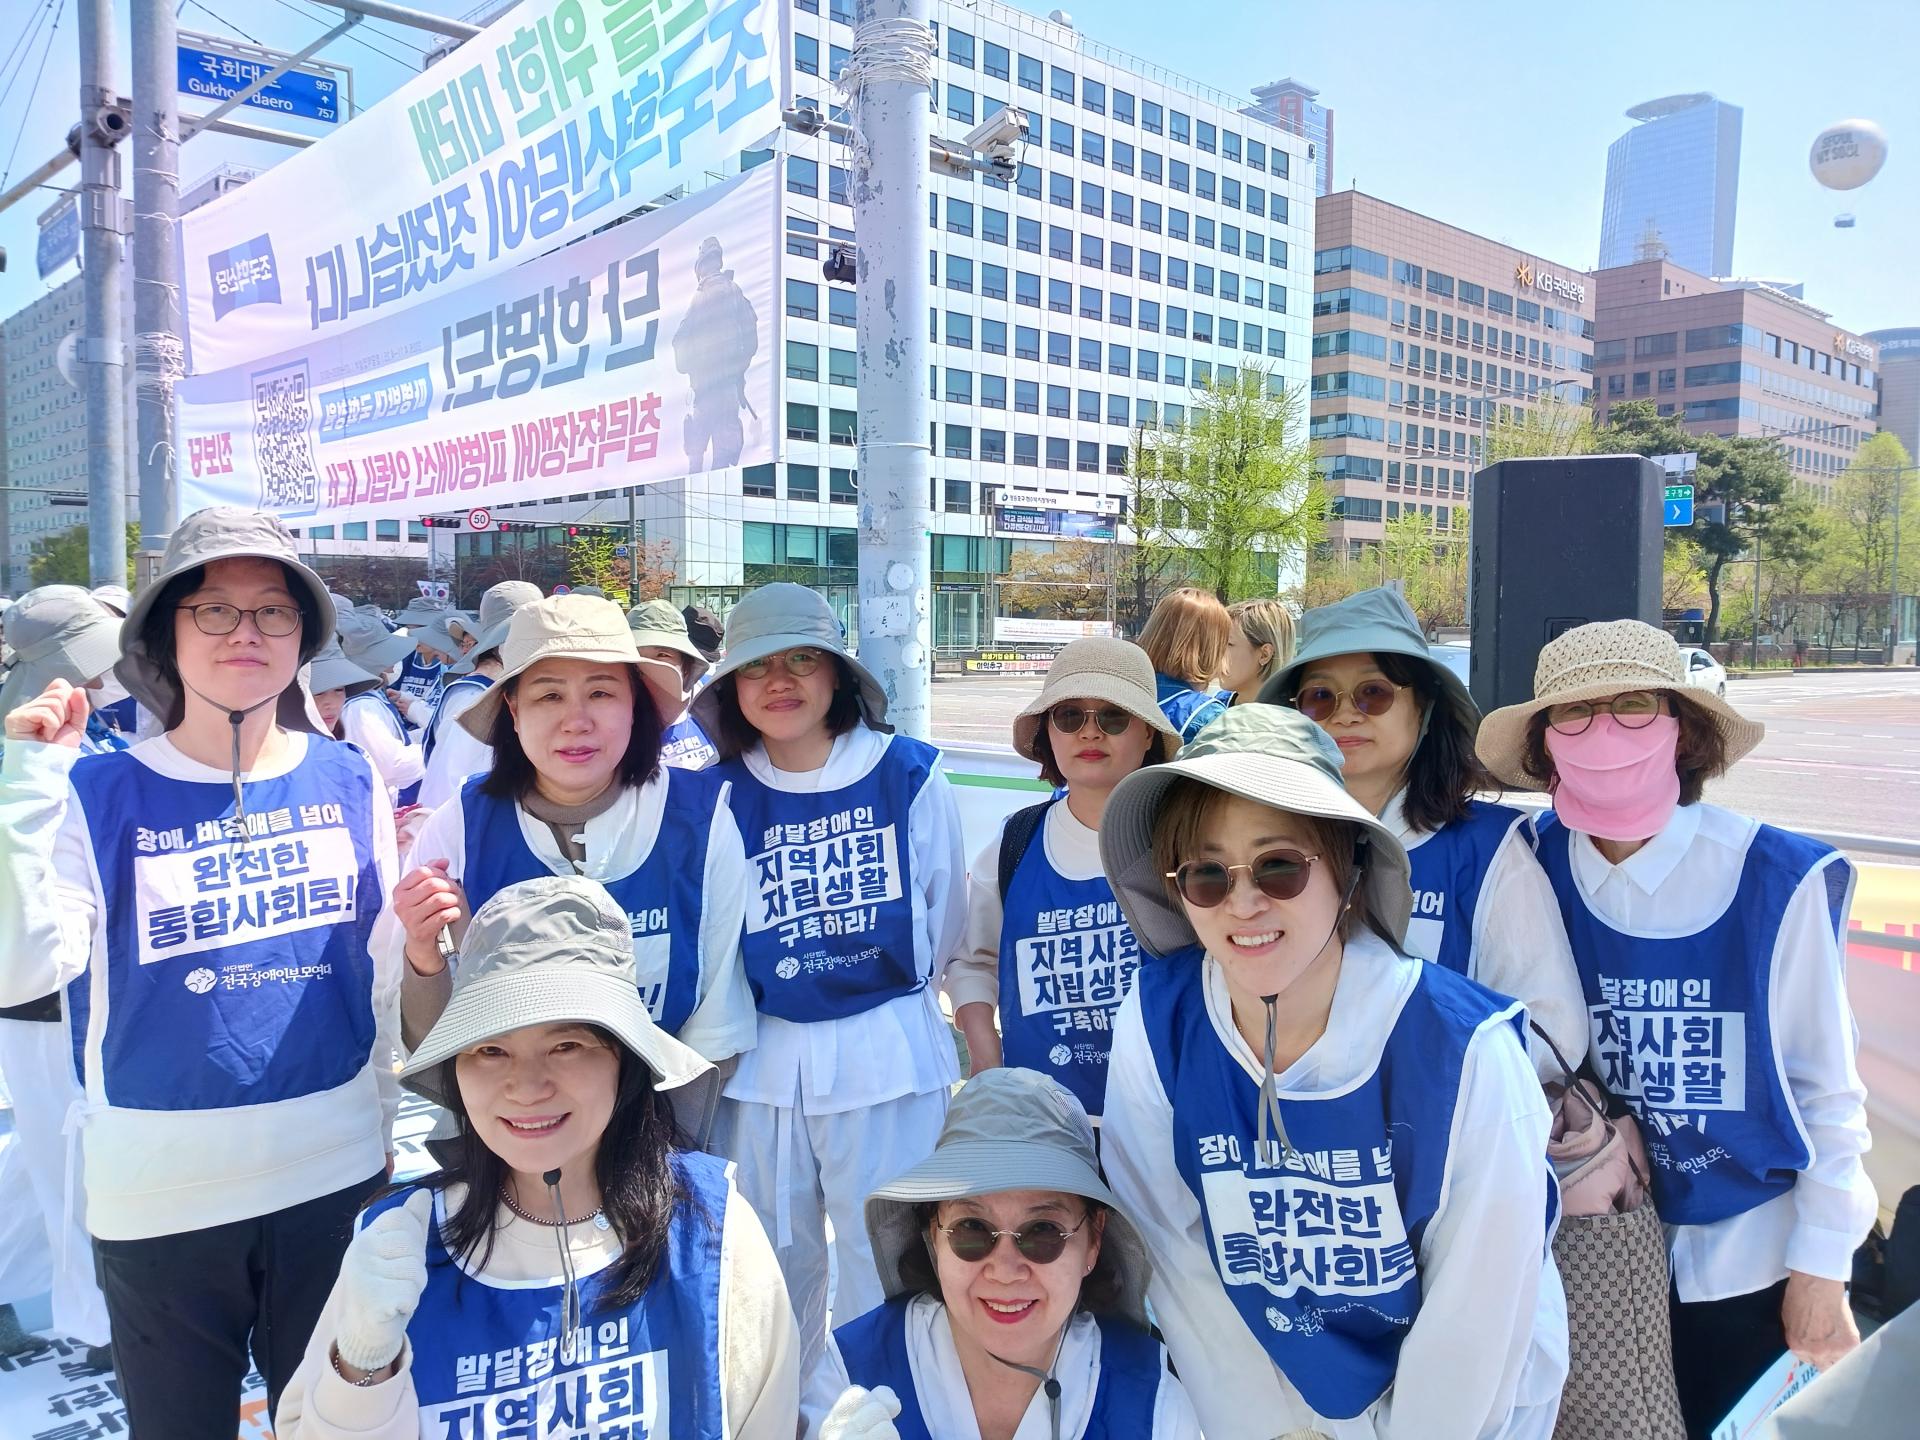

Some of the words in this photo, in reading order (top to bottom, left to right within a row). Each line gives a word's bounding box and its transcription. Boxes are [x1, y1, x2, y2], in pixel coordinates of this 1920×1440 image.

[188, 77, 294, 111] Gukhodaero
[315, 80, 334, 92] 957
[316, 107, 335, 119] 757
[1536, 271, 1585, 304] KB국민은행
[473, 513, 486, 525] 50
[136, 826, 193, 852] 장애,
[299, 803, 344, 828] 넘어
[763, 806, 874, 850] 발달장애인
[192, 840, 310, 892] 완전한
[756, 832, 885, 888] 지역사회
[148, 875, 355, 950] 통합사회로!
[761, 866, 889, 925] 자립생활
[778, 906, 878, 949] 구축하라!
[1037, 901, 1128, 934] 발달장애
[220, 963, 333, 990] 전국장애인부모연대
[1248, 1188, 1382, 1239] 완전한
[455, 1317, 630, 1395] 발달장애인
